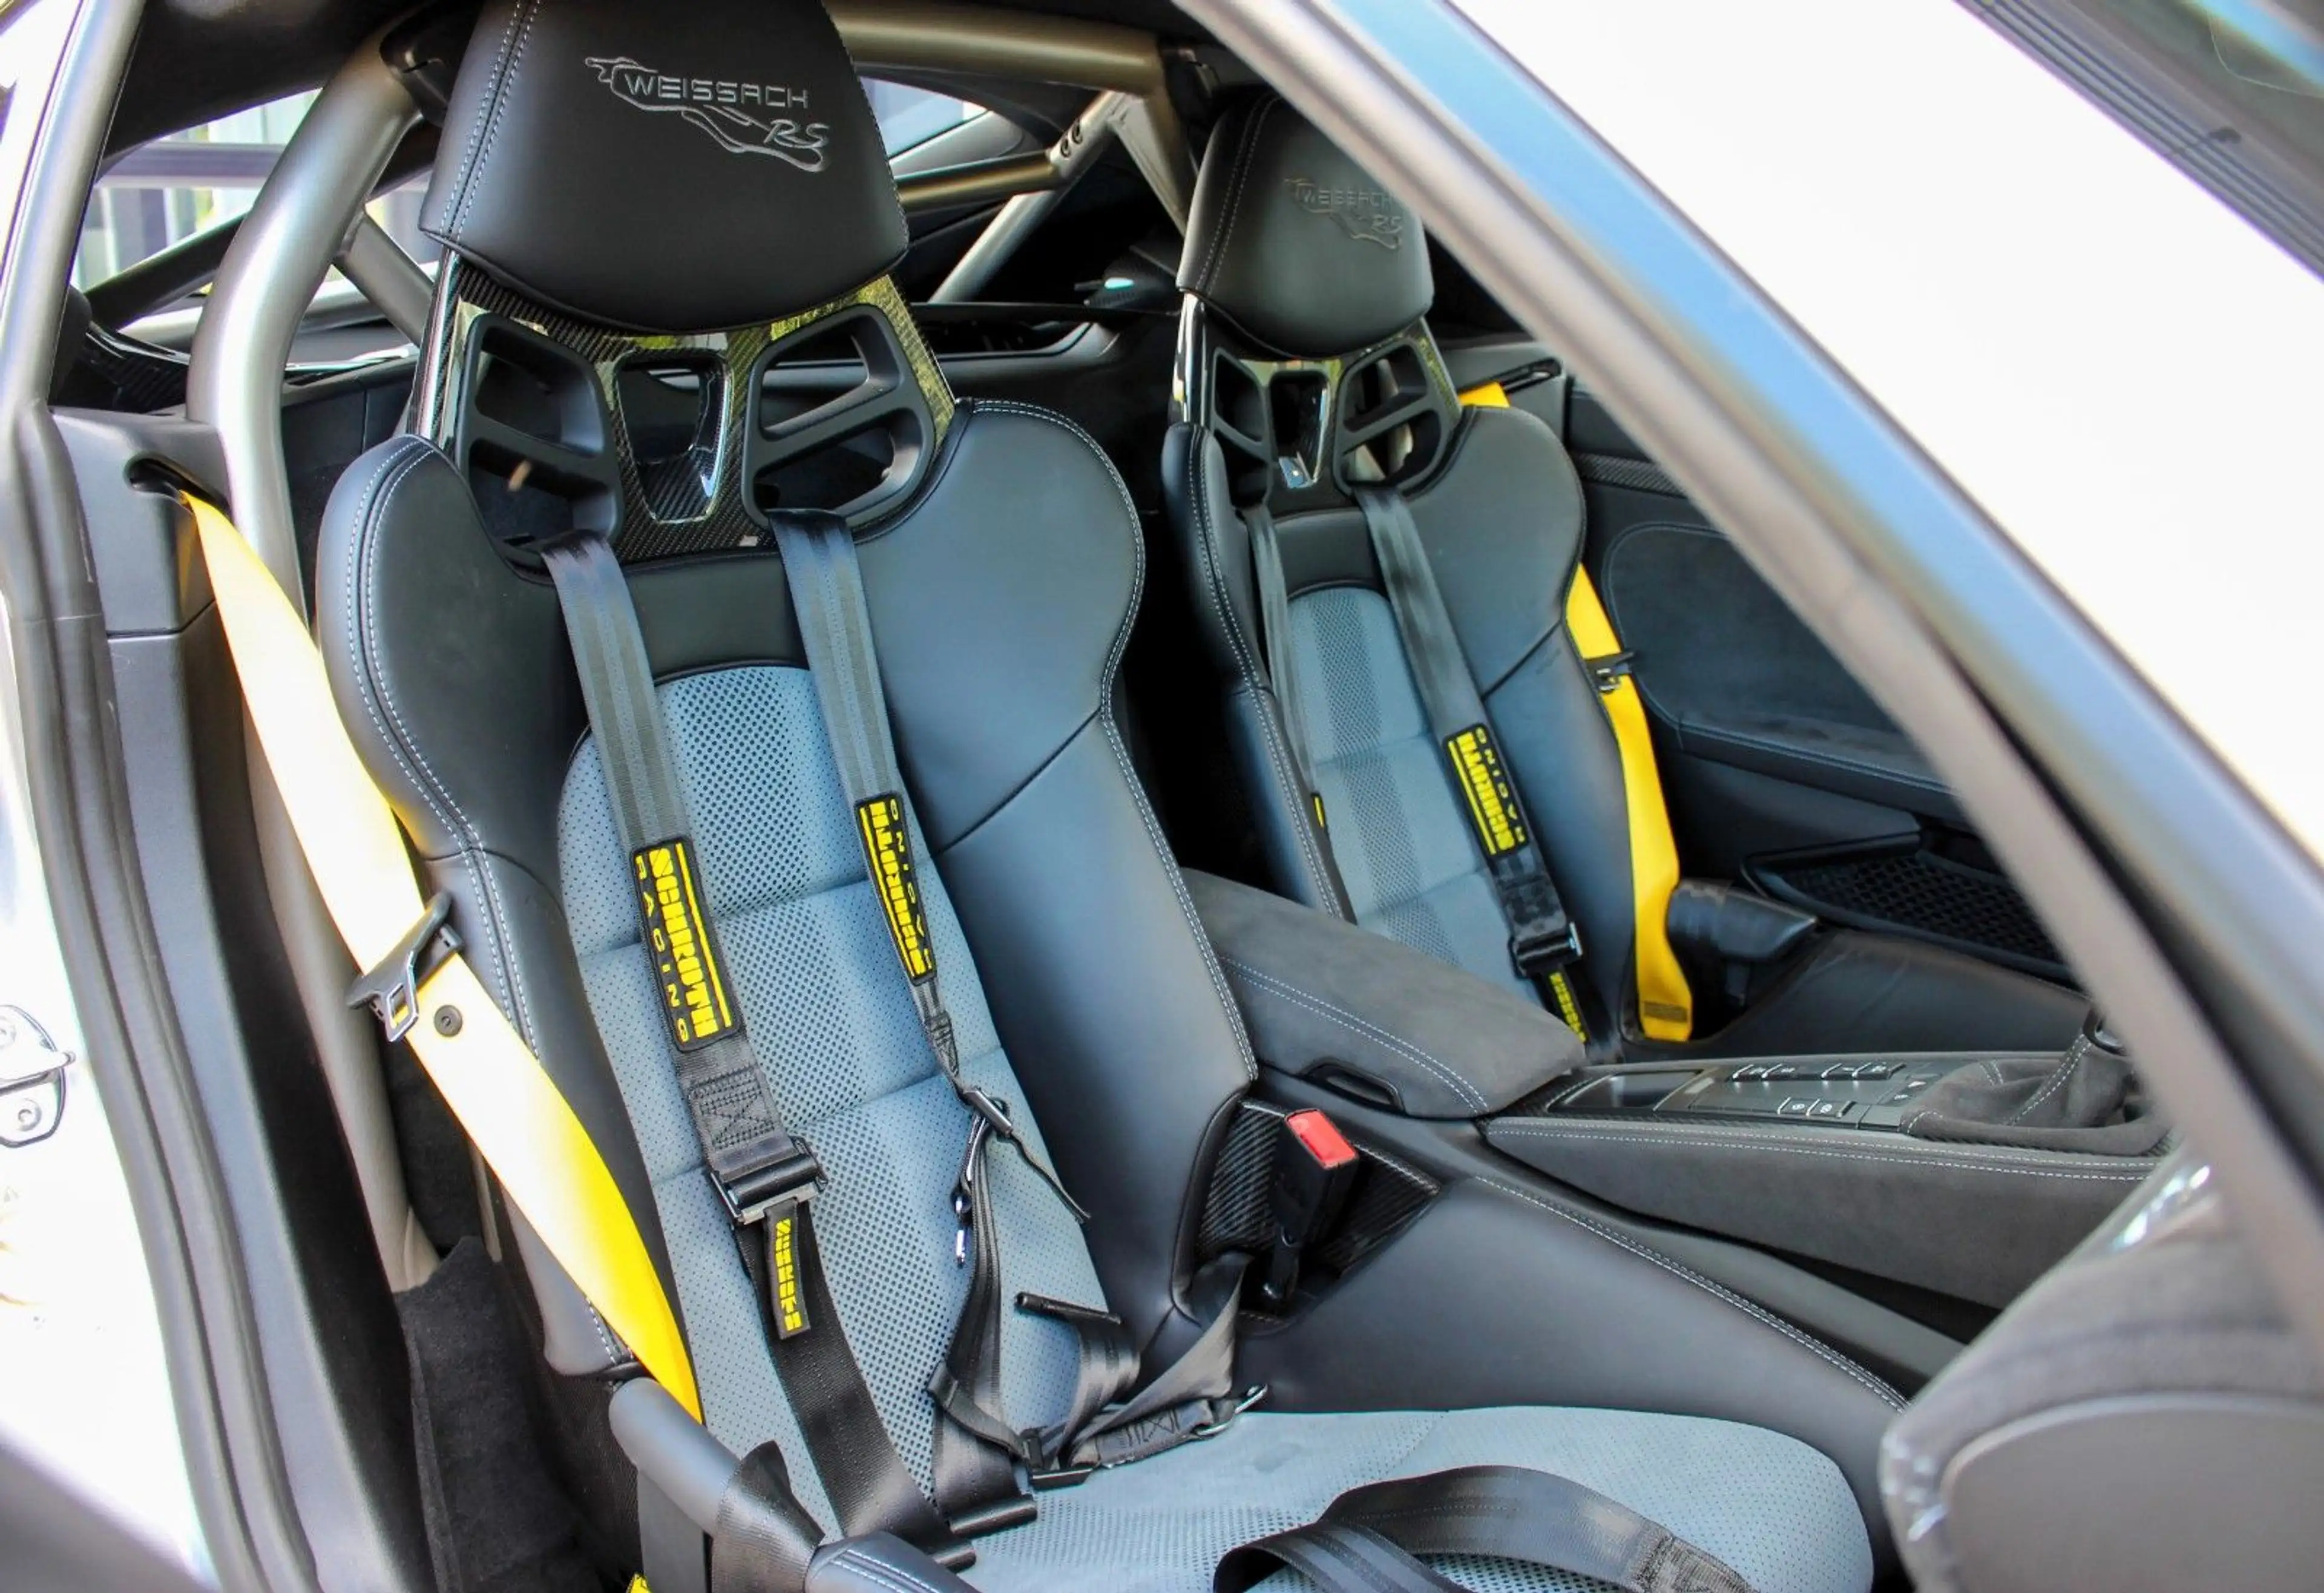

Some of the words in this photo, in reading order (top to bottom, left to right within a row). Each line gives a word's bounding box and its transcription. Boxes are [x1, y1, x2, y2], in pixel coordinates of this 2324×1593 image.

[624, 73, 810, 109] WEISSACH
[763, 119, 831, 150] RS
[1457, 732, 1515, 851] SCHROTH
[1475, 727, 1526, 843] RACING
[649, 847, 719, 1039] SCHROTH
[870, 801, 927, 974] SCHROTH
[890, 798, 932, 970] RACING
[635, 855, 689, 1043] RACING
[775, 1218, 803, 1332] SCHROTH
